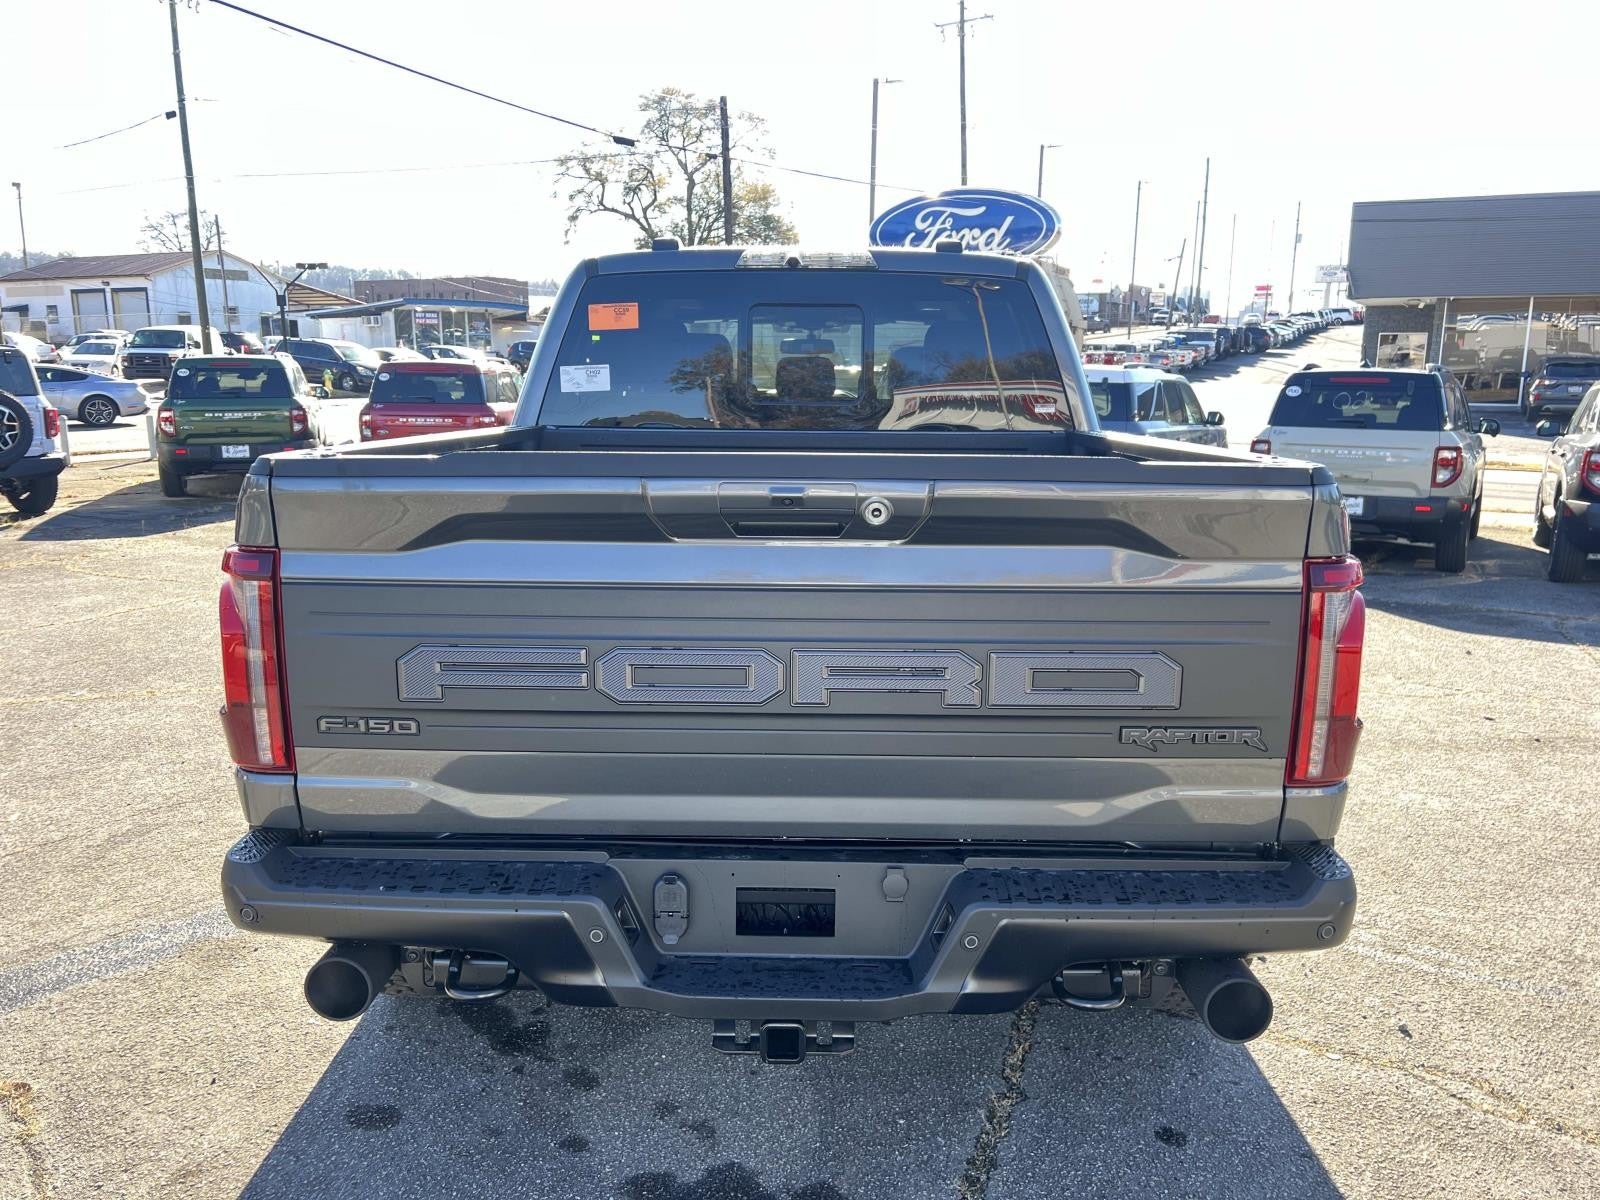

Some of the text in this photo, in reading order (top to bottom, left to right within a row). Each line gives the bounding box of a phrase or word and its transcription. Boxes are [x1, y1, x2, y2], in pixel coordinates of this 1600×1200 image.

[905, 206, 1015, 250] Ford
[396, 644, 1183, 708] FORD
[318, 717, 418, 734] F-150
[1121, 727, 1267, 751] RAPTOR
